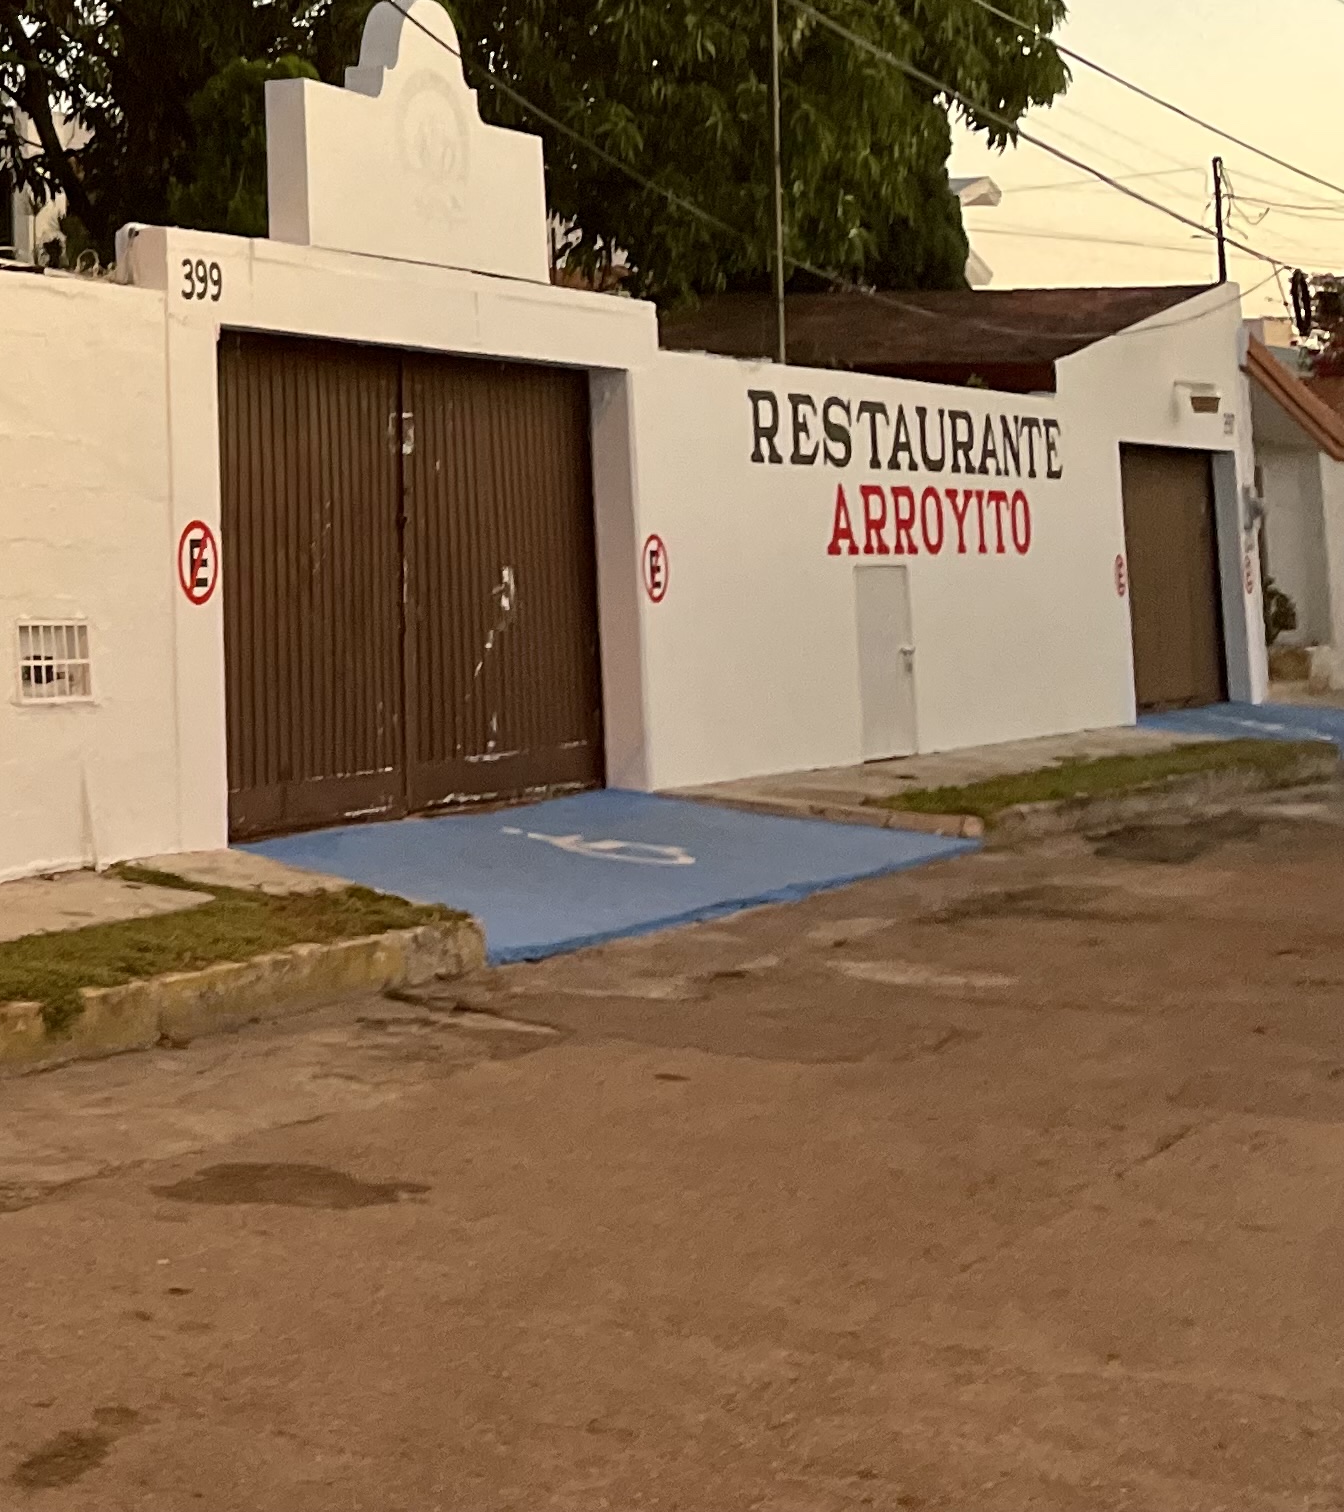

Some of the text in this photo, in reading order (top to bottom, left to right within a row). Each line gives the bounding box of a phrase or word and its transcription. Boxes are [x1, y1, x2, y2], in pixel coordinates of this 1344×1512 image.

[181, 258, 222, 301] 399
[748, 390, 1063, 479] RESTAURANTE
[827, 485, 1032, 556] ARROYITO
